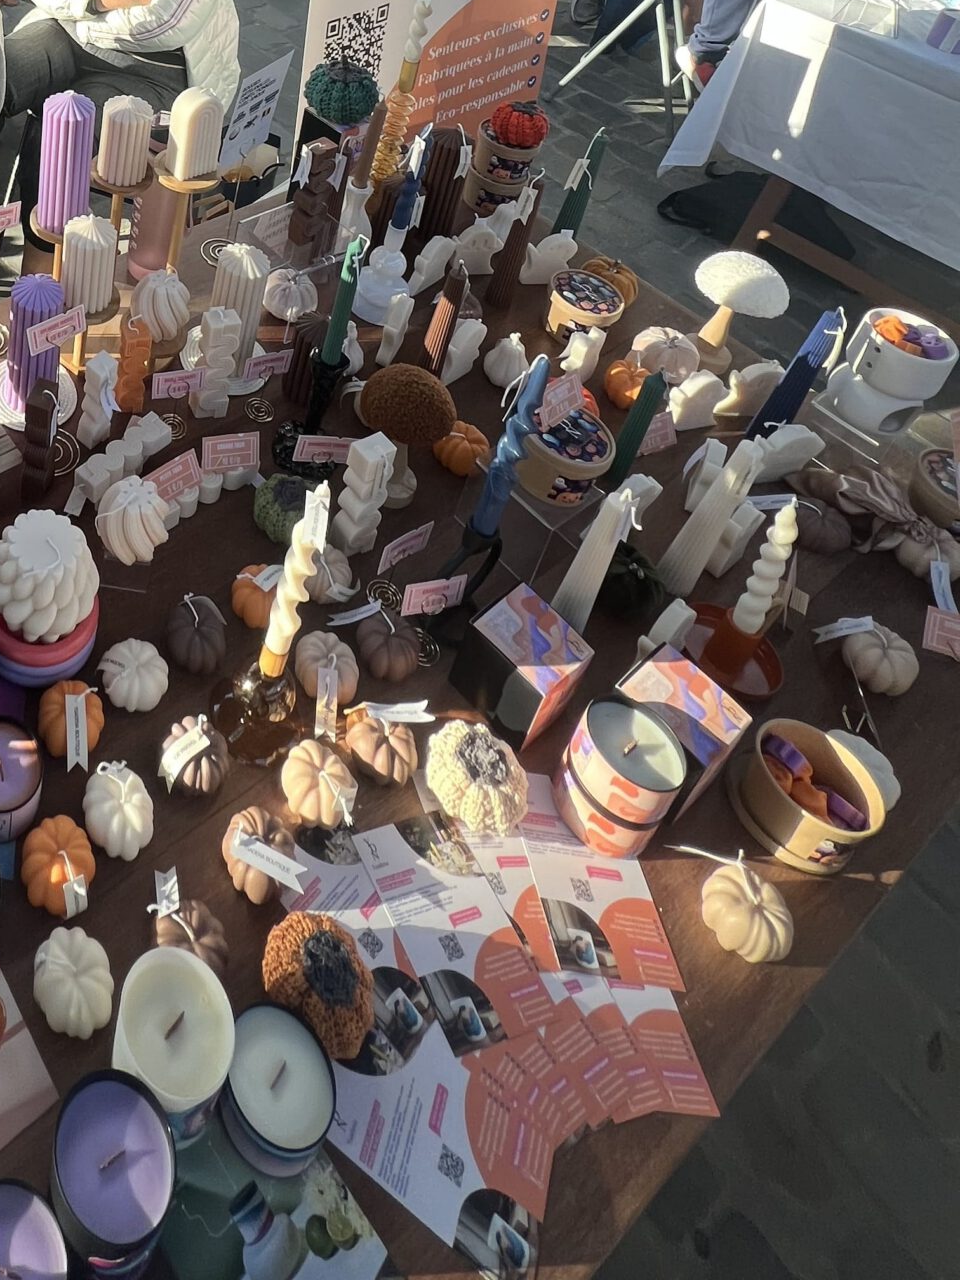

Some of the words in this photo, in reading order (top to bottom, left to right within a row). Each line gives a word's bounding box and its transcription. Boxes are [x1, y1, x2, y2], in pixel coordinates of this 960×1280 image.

[427, 32, 481, 61] Senteurs
[483, 12, 539, 41] exclusives
[418, 55, 483, 86] Fabriquées
[485, 52, 492, 63] à
[495, 46, 505, 59] la
[507, 36, 534, 54] main
[437, 82, 466, 104] pour
[468, 74, 484, 90] les
[487, 59, 529, 82] cadeaux
[436, 80, 526, 123] Eco-responsable
